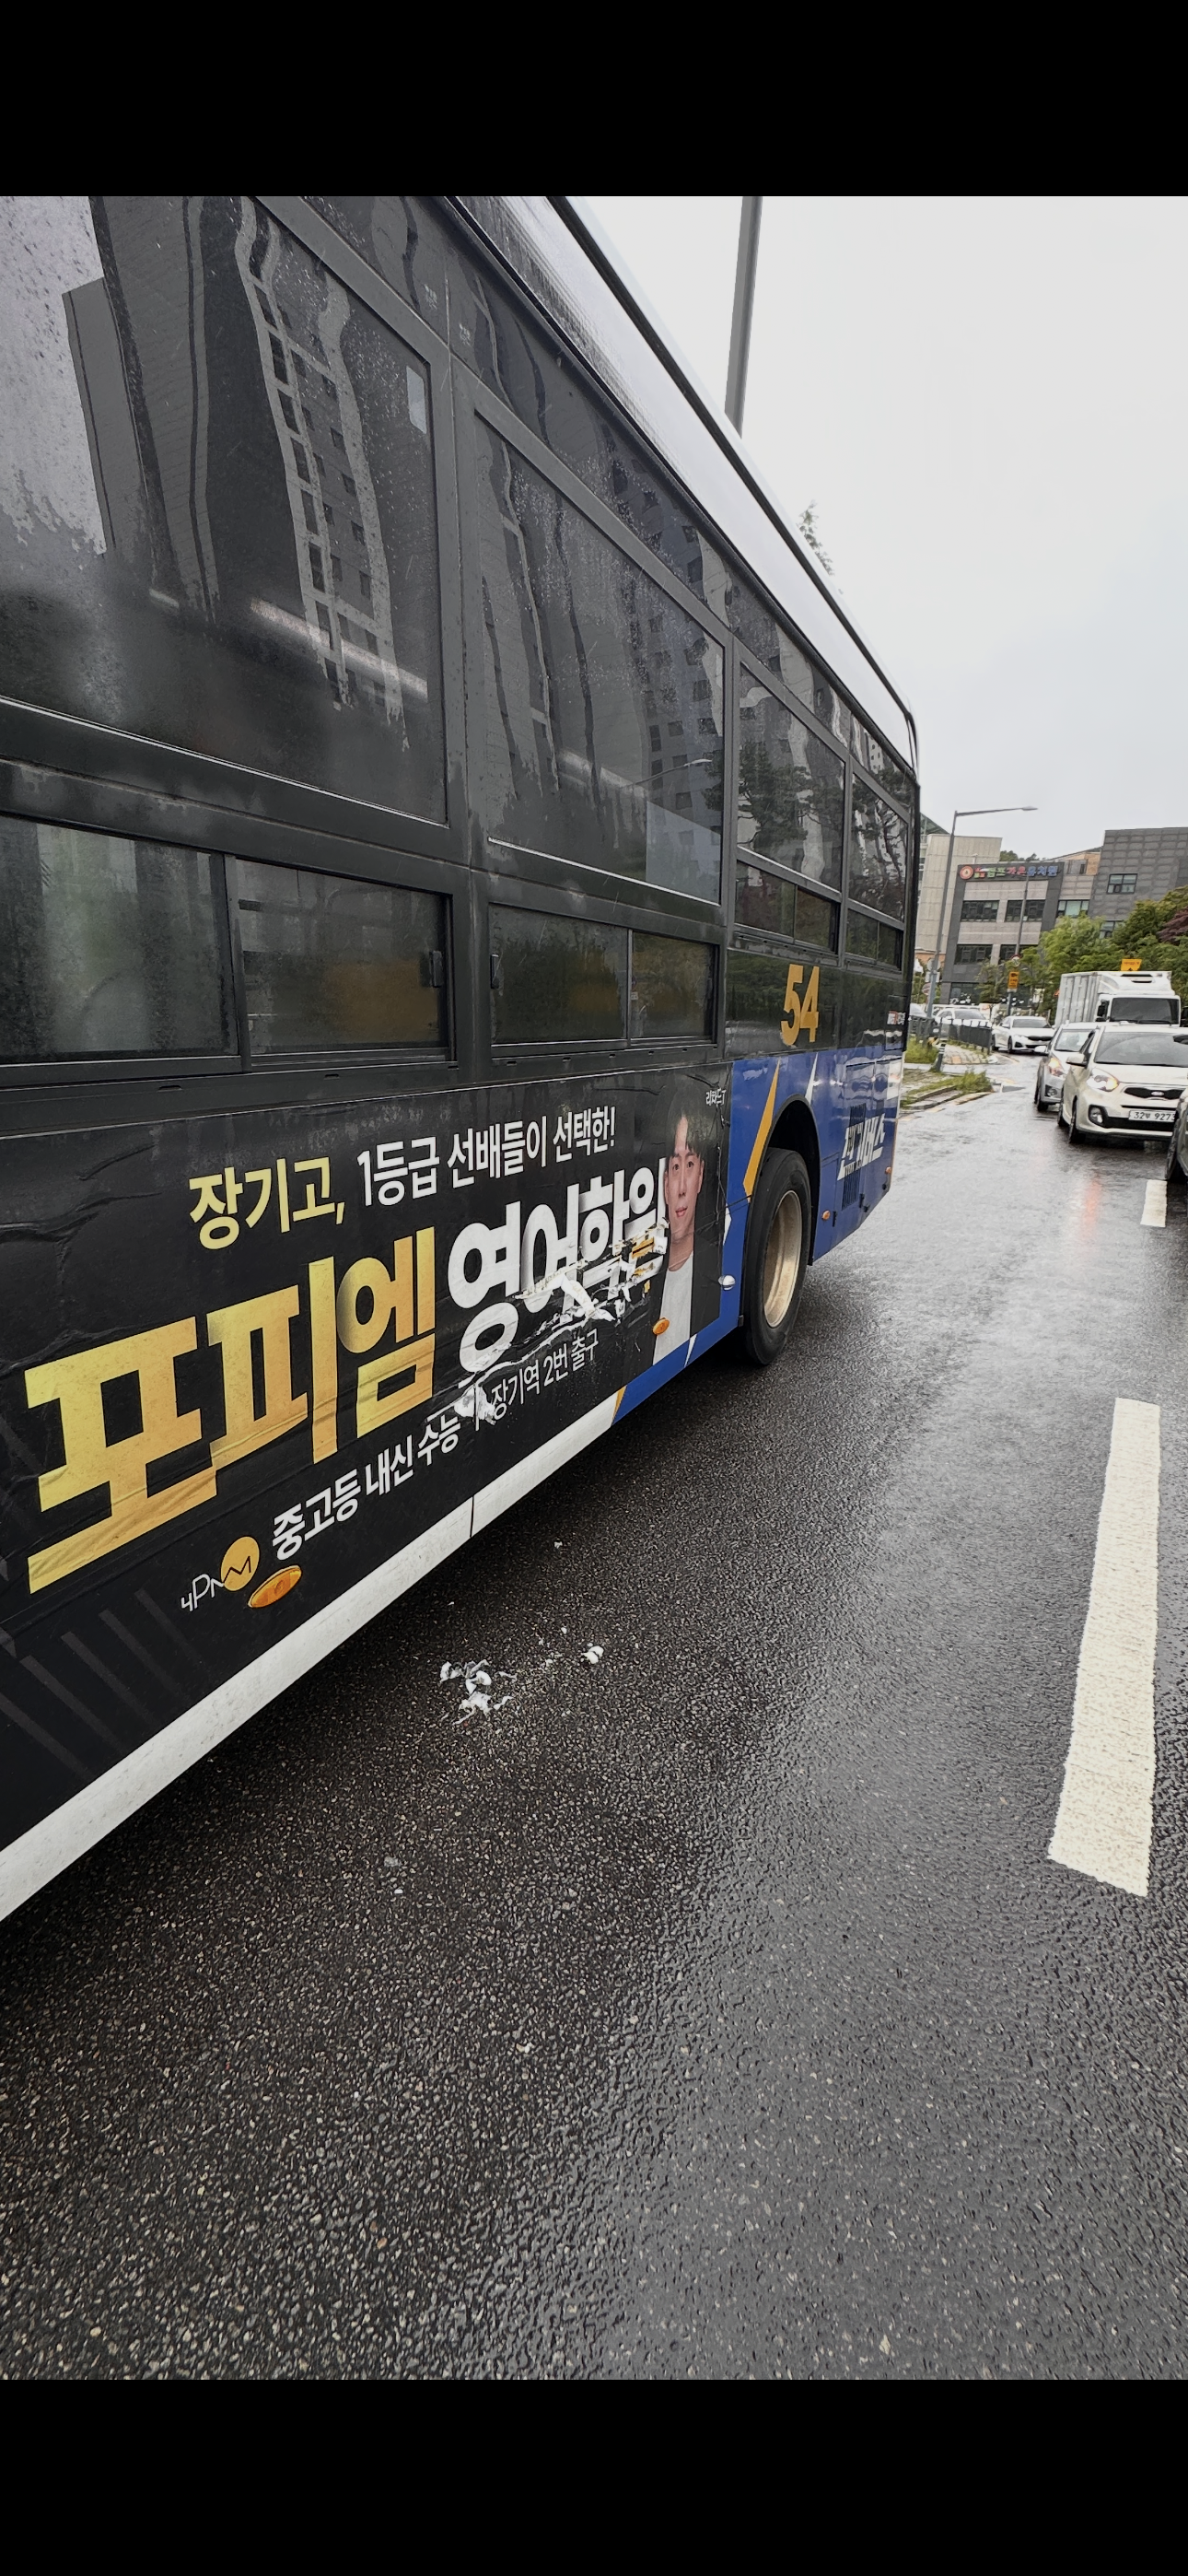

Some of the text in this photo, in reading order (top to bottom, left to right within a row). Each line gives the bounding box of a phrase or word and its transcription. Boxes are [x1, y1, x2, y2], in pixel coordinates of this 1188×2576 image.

[781, 964, 820, 1046] 54
[189, 1106, 616, 1249] 장기고, 1등급 선배들이 선택한!
[24, 1226, 436, 1594] 포피엠
[273, 1329, 599, 1560] 중고등 내신 수능 장기역 2번 출구
